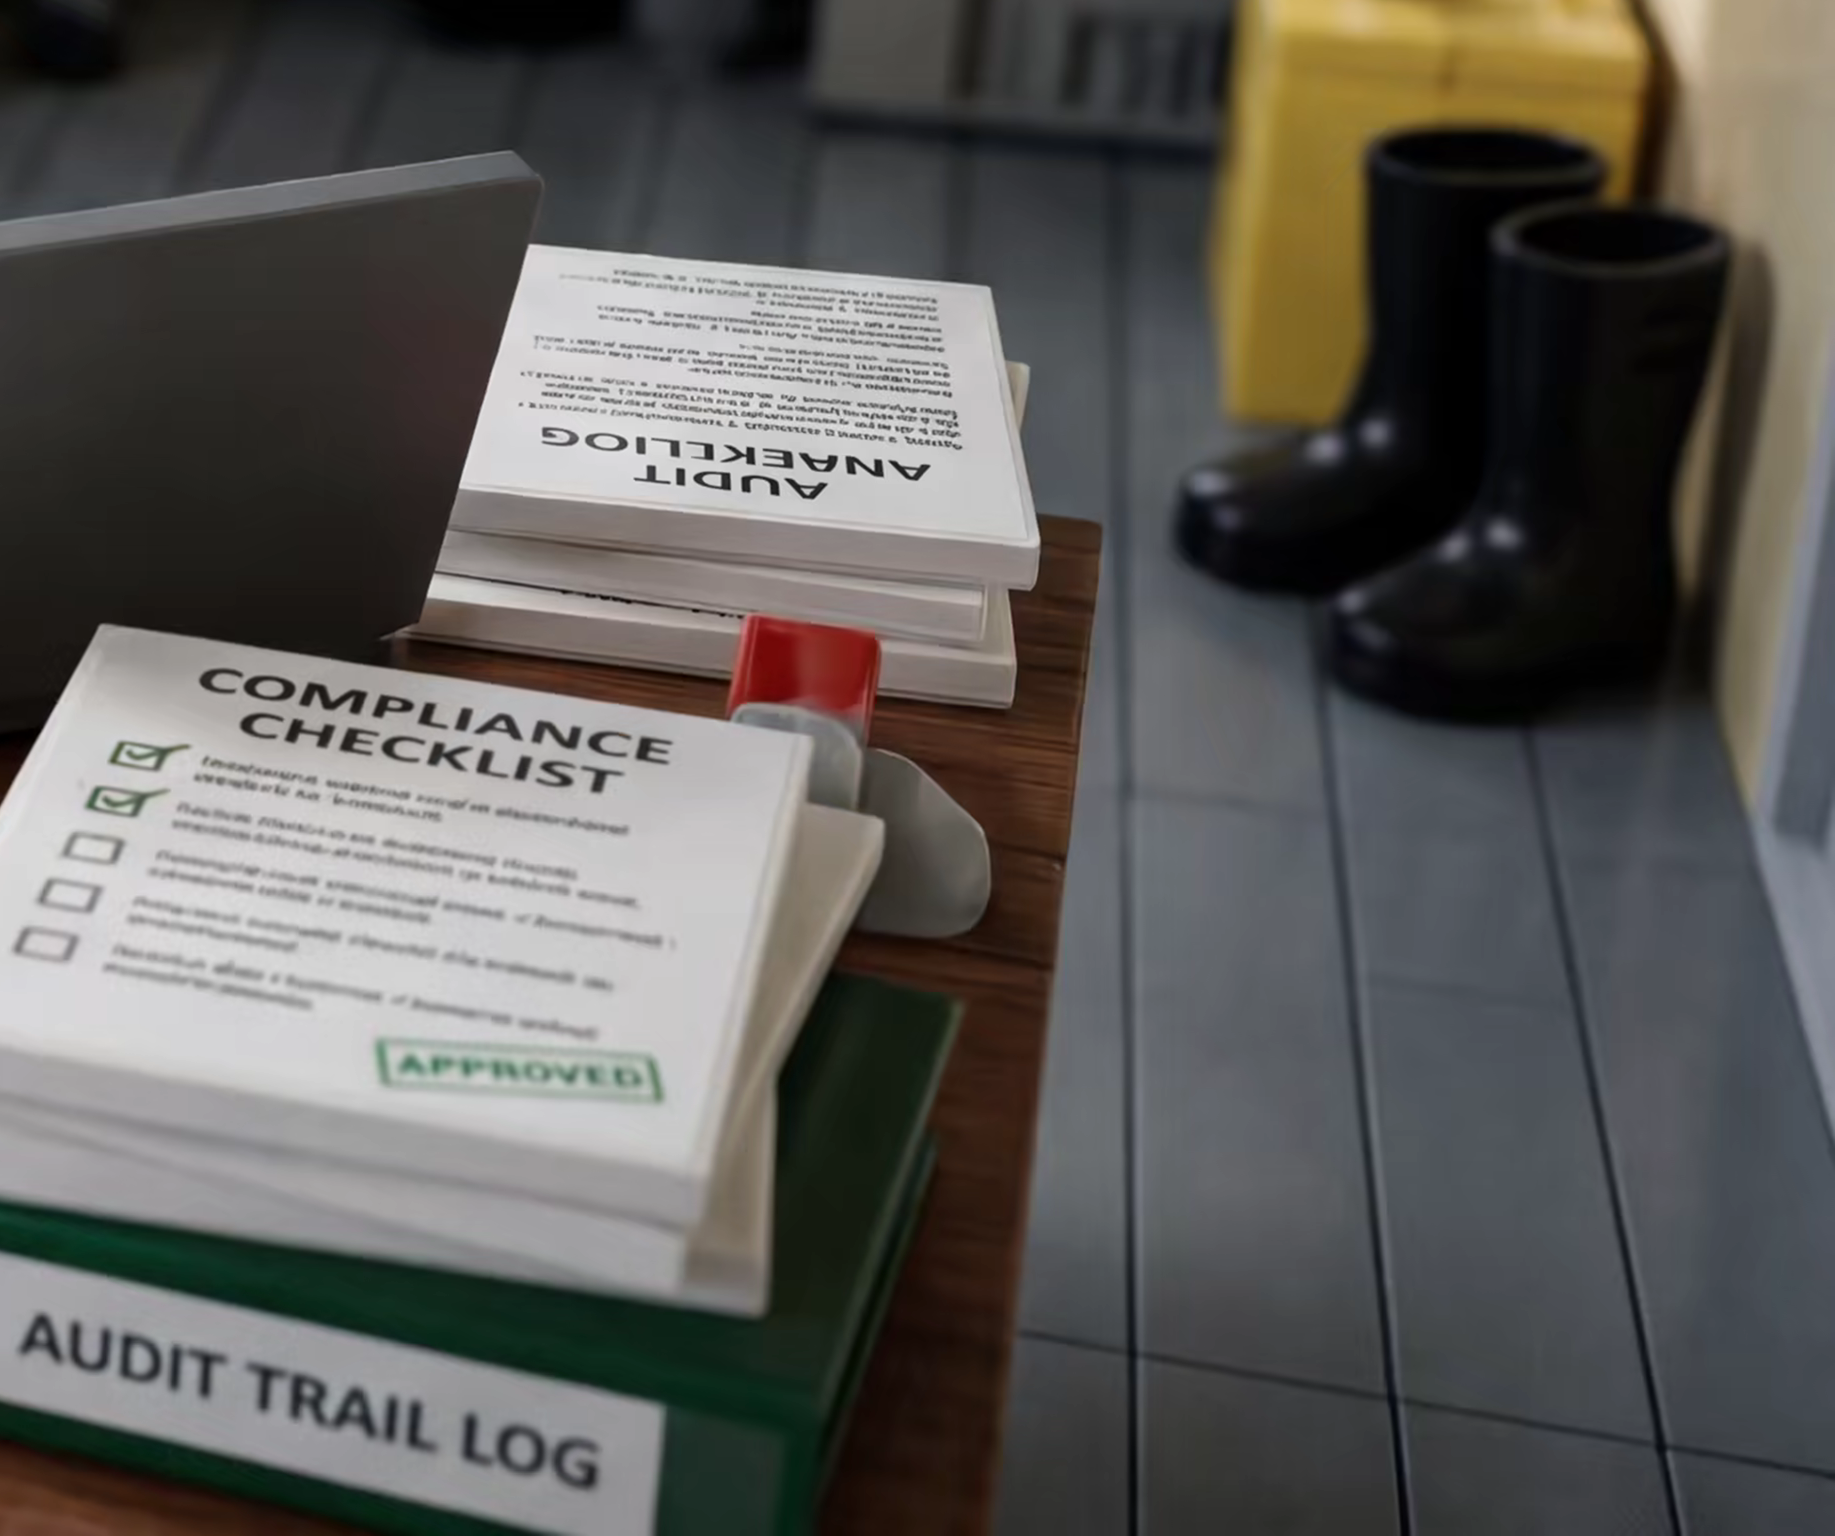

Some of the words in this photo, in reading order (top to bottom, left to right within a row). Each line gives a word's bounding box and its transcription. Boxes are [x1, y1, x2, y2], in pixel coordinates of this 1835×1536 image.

[632, 464, 830, 500] AUDIT
[198, 667, 674, 765] COMPLIANCE
[239, 712, 625, 795] CHECKLIST
[397, 1052, 643, 1088] APPROVED
[17, 1311, 228, 1399] AUDIT
[246, 1361, 438, 1453] TRAIL
[460, 1412, 603, 1491] LOG
